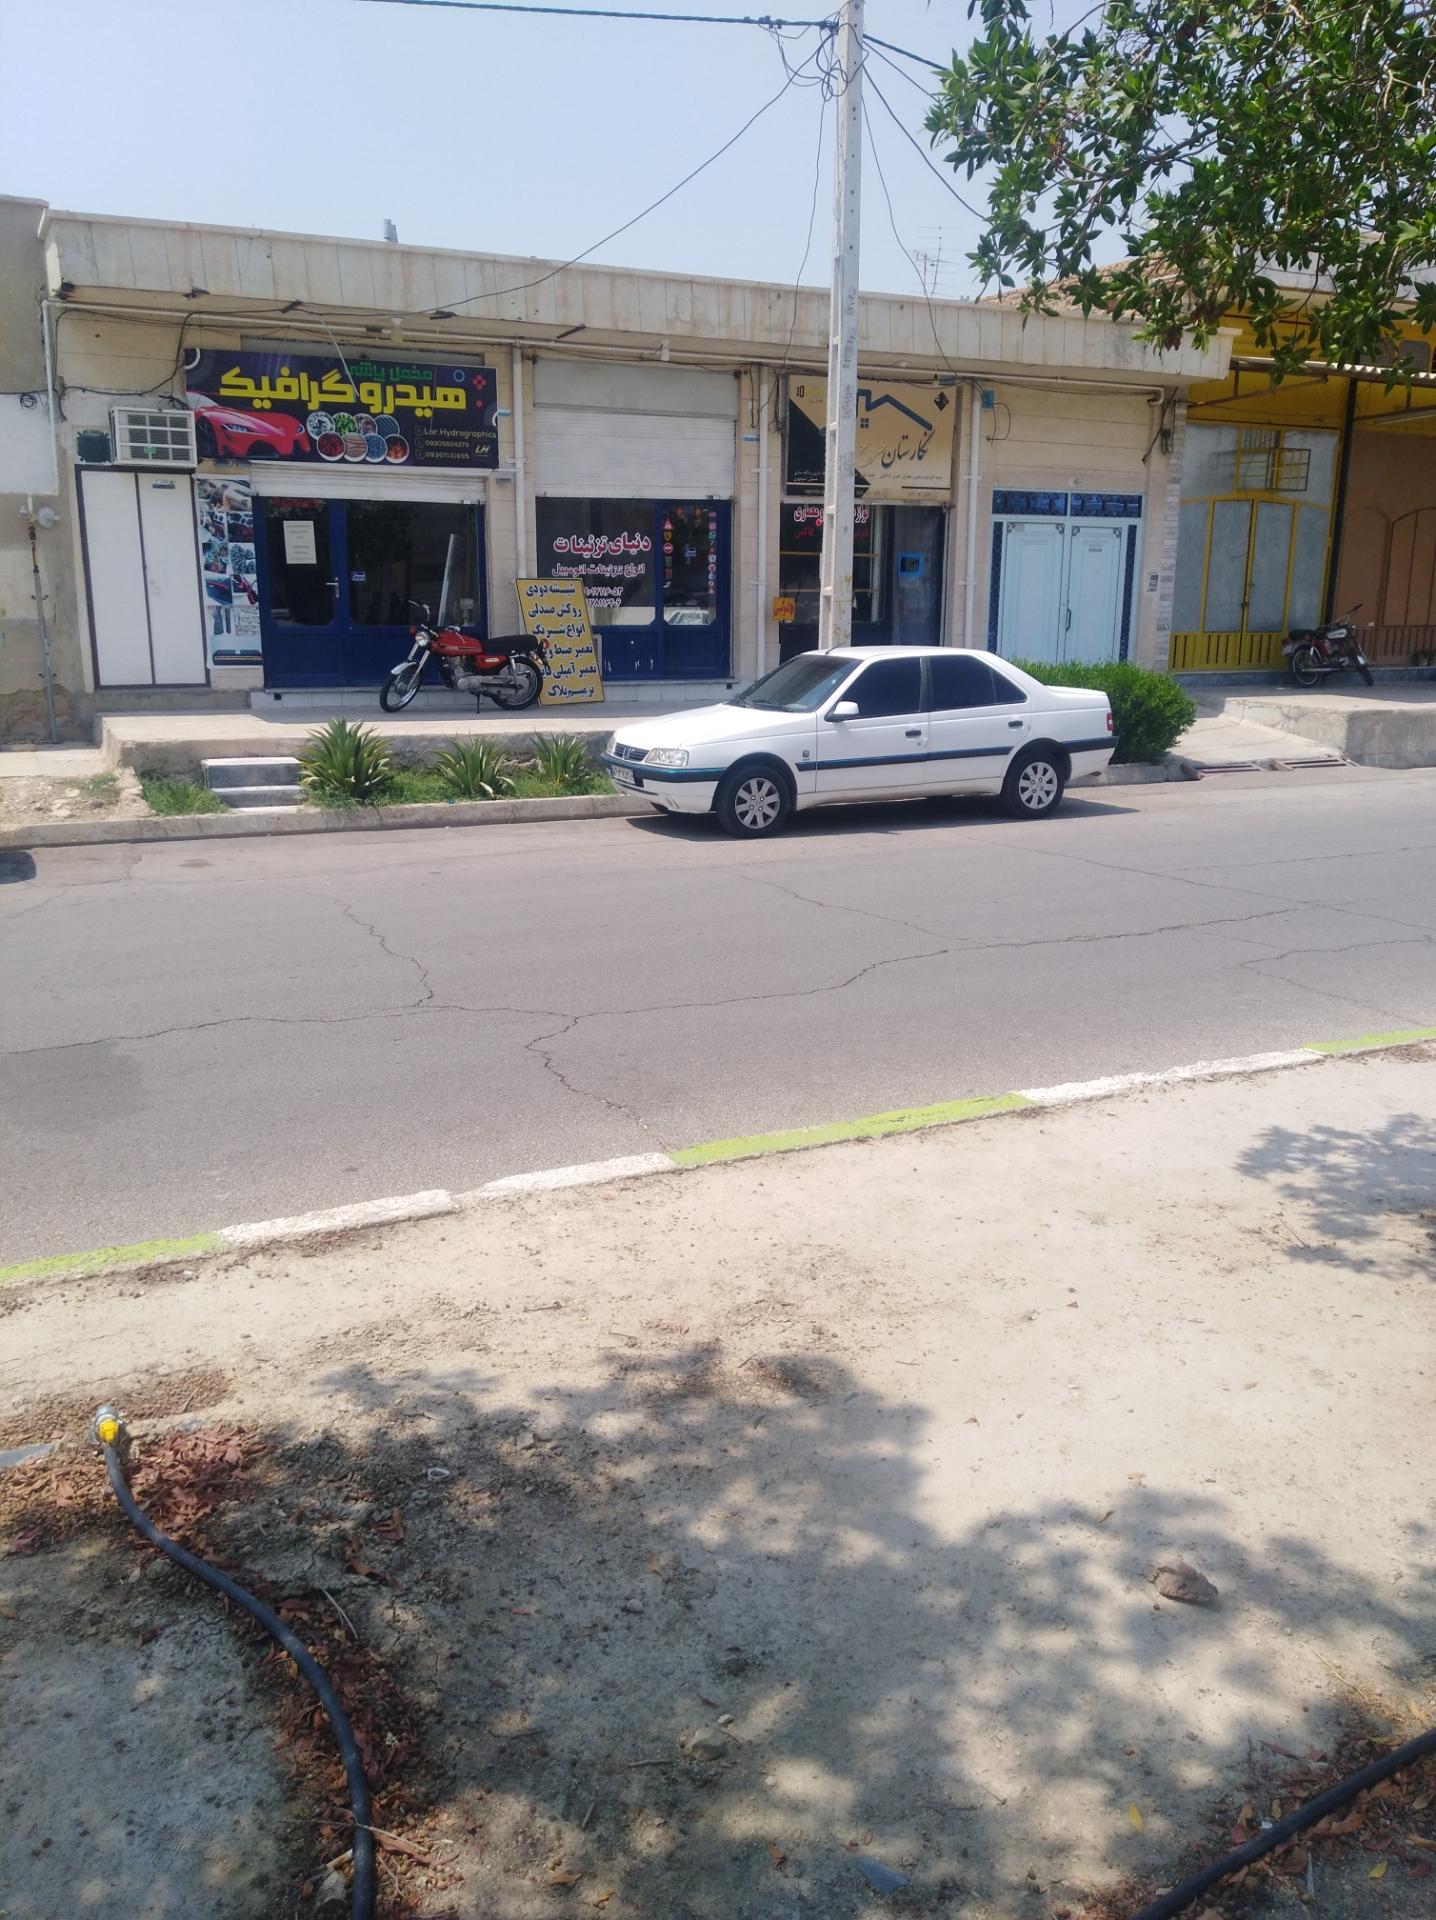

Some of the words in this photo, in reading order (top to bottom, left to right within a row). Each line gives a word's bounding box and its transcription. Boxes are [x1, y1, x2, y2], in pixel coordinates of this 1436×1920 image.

[390, 365, 432, 381] مخمل
[424, 428, 497, 439] Lar.Hydrographics
[881, 428, 935, 468] نگارستان
[553, 534, 609, 558] تزئینات
[609, 531, 651, 555] دنیای
[624, 563, 645, 577] انواع
[526, 585, 548, 597] دودی
[549, 582, 576, 596] شیشه
[528, 603, 555, 618] صندلی
[556, 603, 582, 618] روکش
[566, 623, 586, 637] انواع
[575, 643, 593, 658] تعمیر
[578, 664, 597, 678] تعمیر
[547, 684, 568, 699] پلاک
